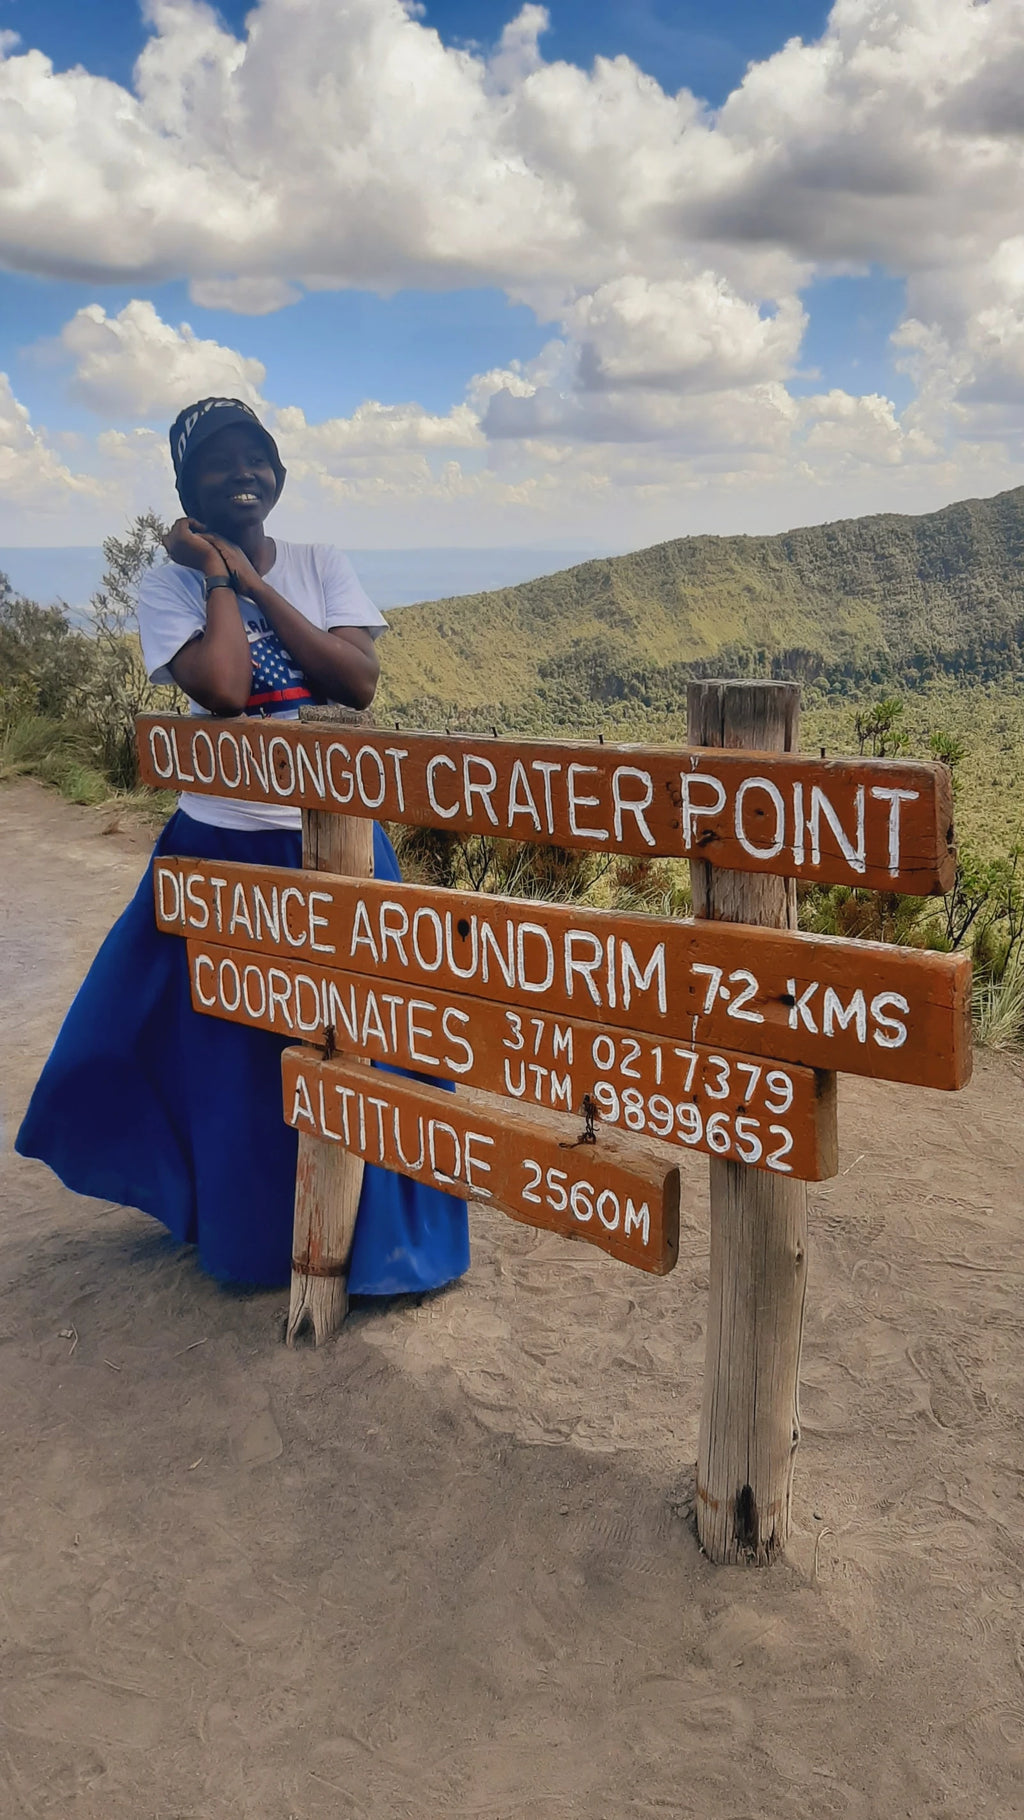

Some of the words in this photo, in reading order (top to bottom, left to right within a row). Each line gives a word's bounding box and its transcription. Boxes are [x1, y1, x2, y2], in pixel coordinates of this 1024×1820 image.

[149, 725, 408, 813] OLOONONGOT
[426, 754, 656, 847] CRATER
[680, 770, 920, 878] POINT
[155, 868, 336, 955] DISTANCE
[350, 900, 554, 993] AROUND
[564, 929, 668, 1015] RIM
[786, 977, 909, 1050] KMS
[194, 954, 474, 1074] COORDINATES
[502, 1011, 574, 1065] 37M
[592, 1035, 794, 1114] 0217379
[504, 1058, 573, 1112] UTM
[594, 1080, 794, 1173] 9899652
[290, 1074, 495, 1199] ALTITUDE
[522, 1159, 651, 1246] 2560M
